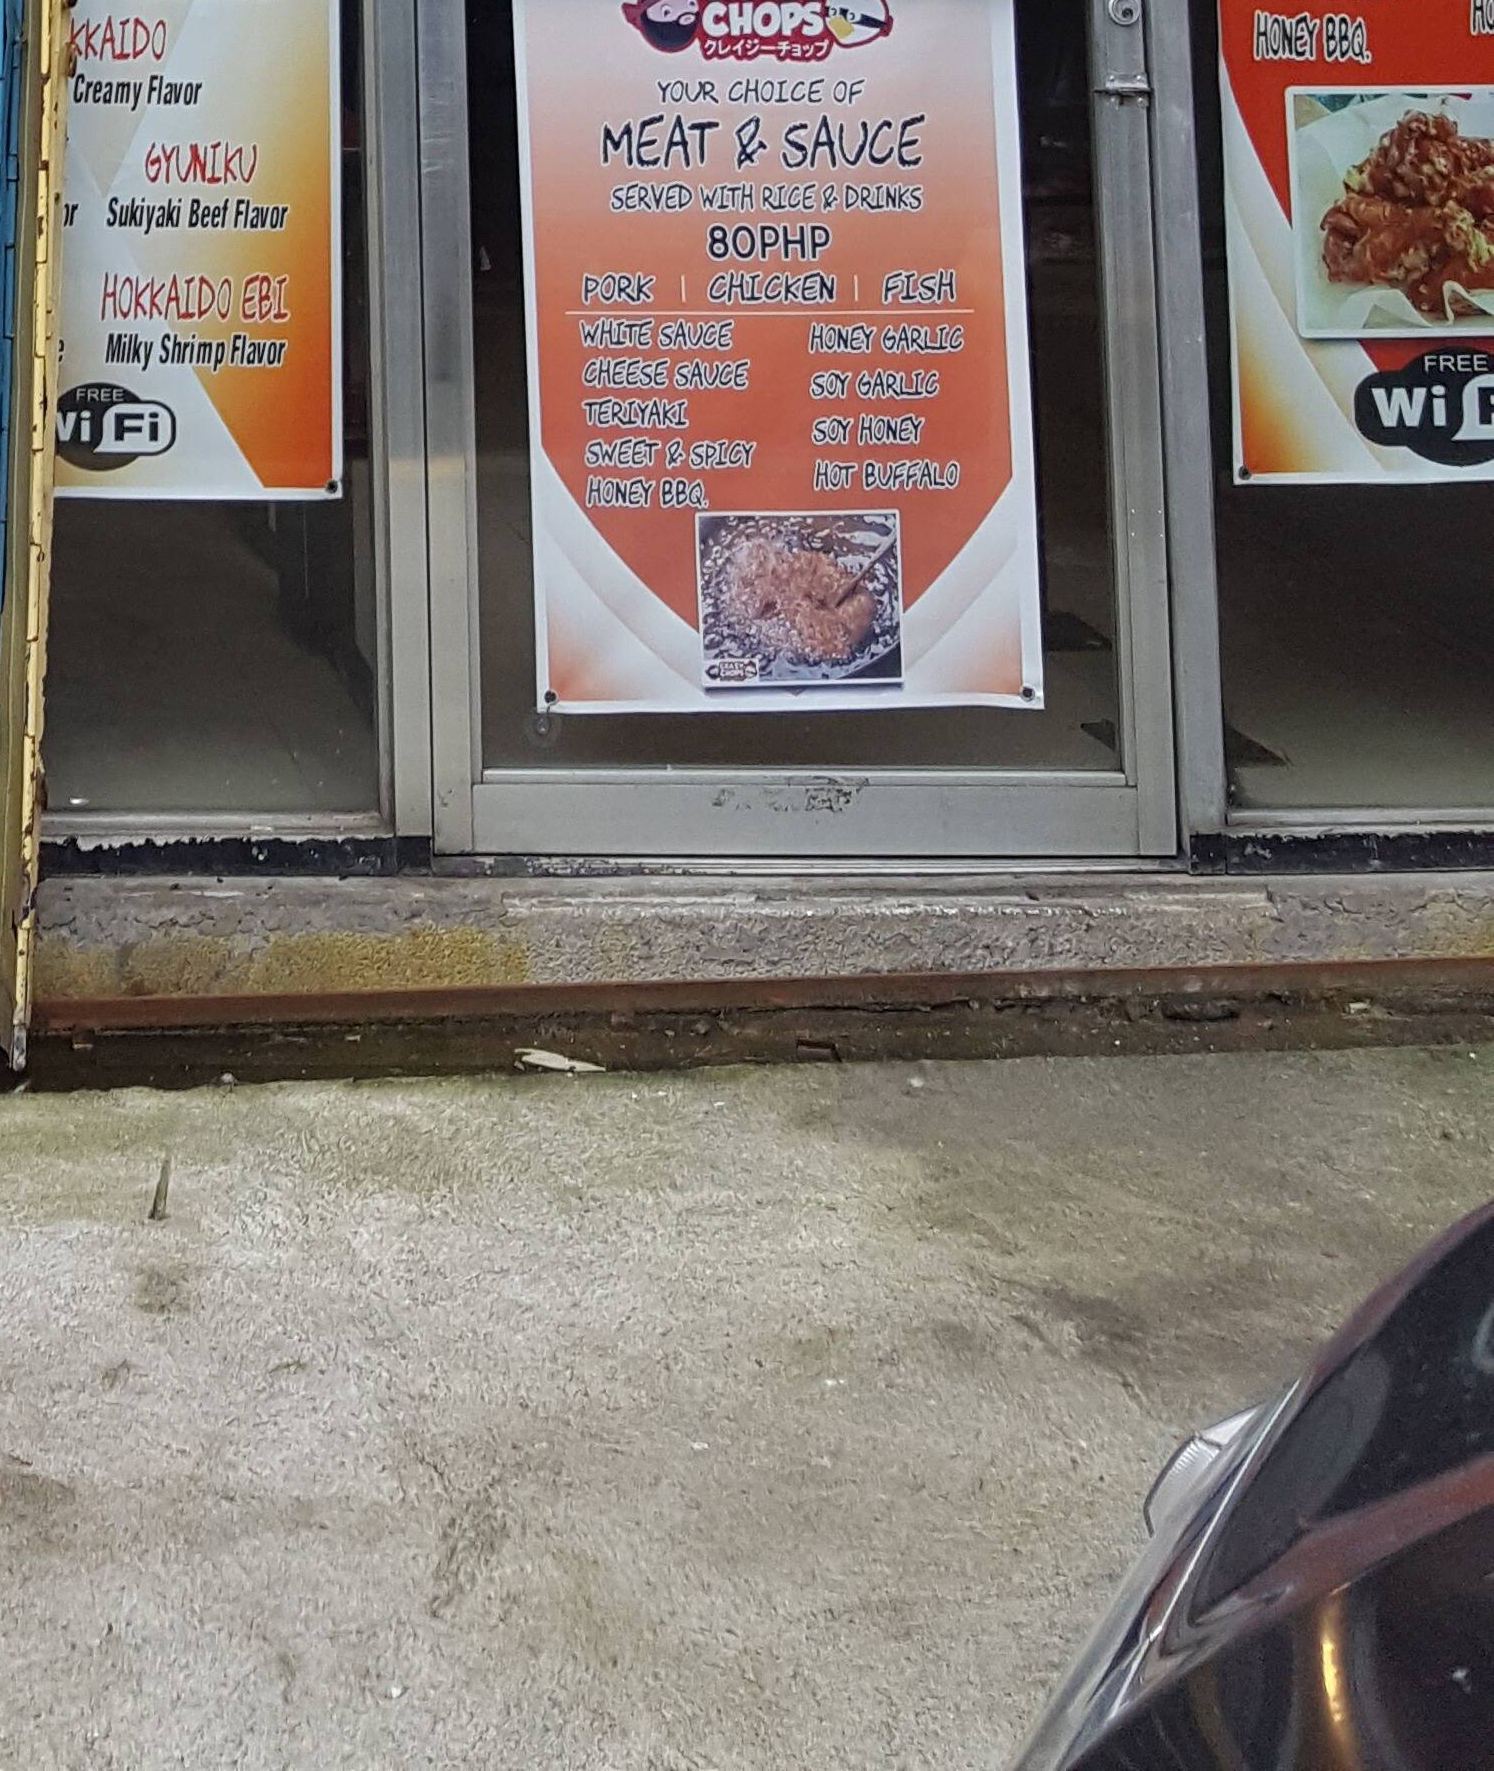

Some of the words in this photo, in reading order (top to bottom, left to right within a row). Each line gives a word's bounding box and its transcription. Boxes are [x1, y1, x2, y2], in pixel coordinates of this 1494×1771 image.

[701, 1, 824, 37] CHOPS
[69, 15, 167, 61] KKAIDO
[704, 38, 830, 57] クレイジーチョップ
[1256, 12, 1317, 58] HONEY
[1325, 15, 1372, 59] BBQ.
[73, 73, 144, 112] Creamy
[147, 74, 203, 106] Flavor
[658, 80, 719, 104] YOUR
[728, 78, 825, 104] CHOICE
[833, 79, 866, 104] OF
[601, 114, 720, 168] MEAT
[734, 115, 768, 170] &
[781, 114, 926, 168] SAUCE
[144, 141, 257, 185] GYUNIKU
[611, 182, 693, 211] SERVED
[699, 183, 755, 211] WITH
[761, 183, 816, 211] RICE
[822, 184, 838, 210] &
[844, 184, 923, 211] DRINKS
[106, 195, 183, 235] Sukiyaki
[187, 197, 229, 229] Beef
[233, 198, 289, 229] Flavor
[708, 224, 831, 260] 80PHP
[100, 272, 232, 321] HOKKAIDO
[241, 273, 289, 321] EBI
[583, 274, 655, 303] PORK
[708, 272, 836, 303] CHICKEN
[882, 270, 956, 303] FISH
[580, 320, 653, 347] WHITE
[659, 321, 733, 348] SAUCE
[810, 324, 875, 352] HONEY
[882, 325, 963, 352] GARLIC
[105, 332, 154, 371] Milky
[158, 333, 226, 372] Shrimp
[229, 334, 287, 366] Flavor
[1424, 354, 1489, 373] FREE
[583, 359, 669, 386] CHEESE
[675, 360, 749, 387] SAUCE
[811, 372, 849, 397] SOY
[857, 370, 938, 397] GARLIC
[75, 388, 125, 402] FREE
[583, 398, 688, 427] TERIYAKI
[813, 418, 852, 443] SOY
[858, 415, 923, 444] HONEY
[586, 438, 660, 466] SWEET
[666, 439, 684, 466] &
[690, 441, 755, 467] SPICY
[814, 462, 856, 489] HOT
[864, 462, 958, 489] BUFFALO
[586, 477, 653, 505] HONEY
[661, 479, 708, 507] BBQ.
